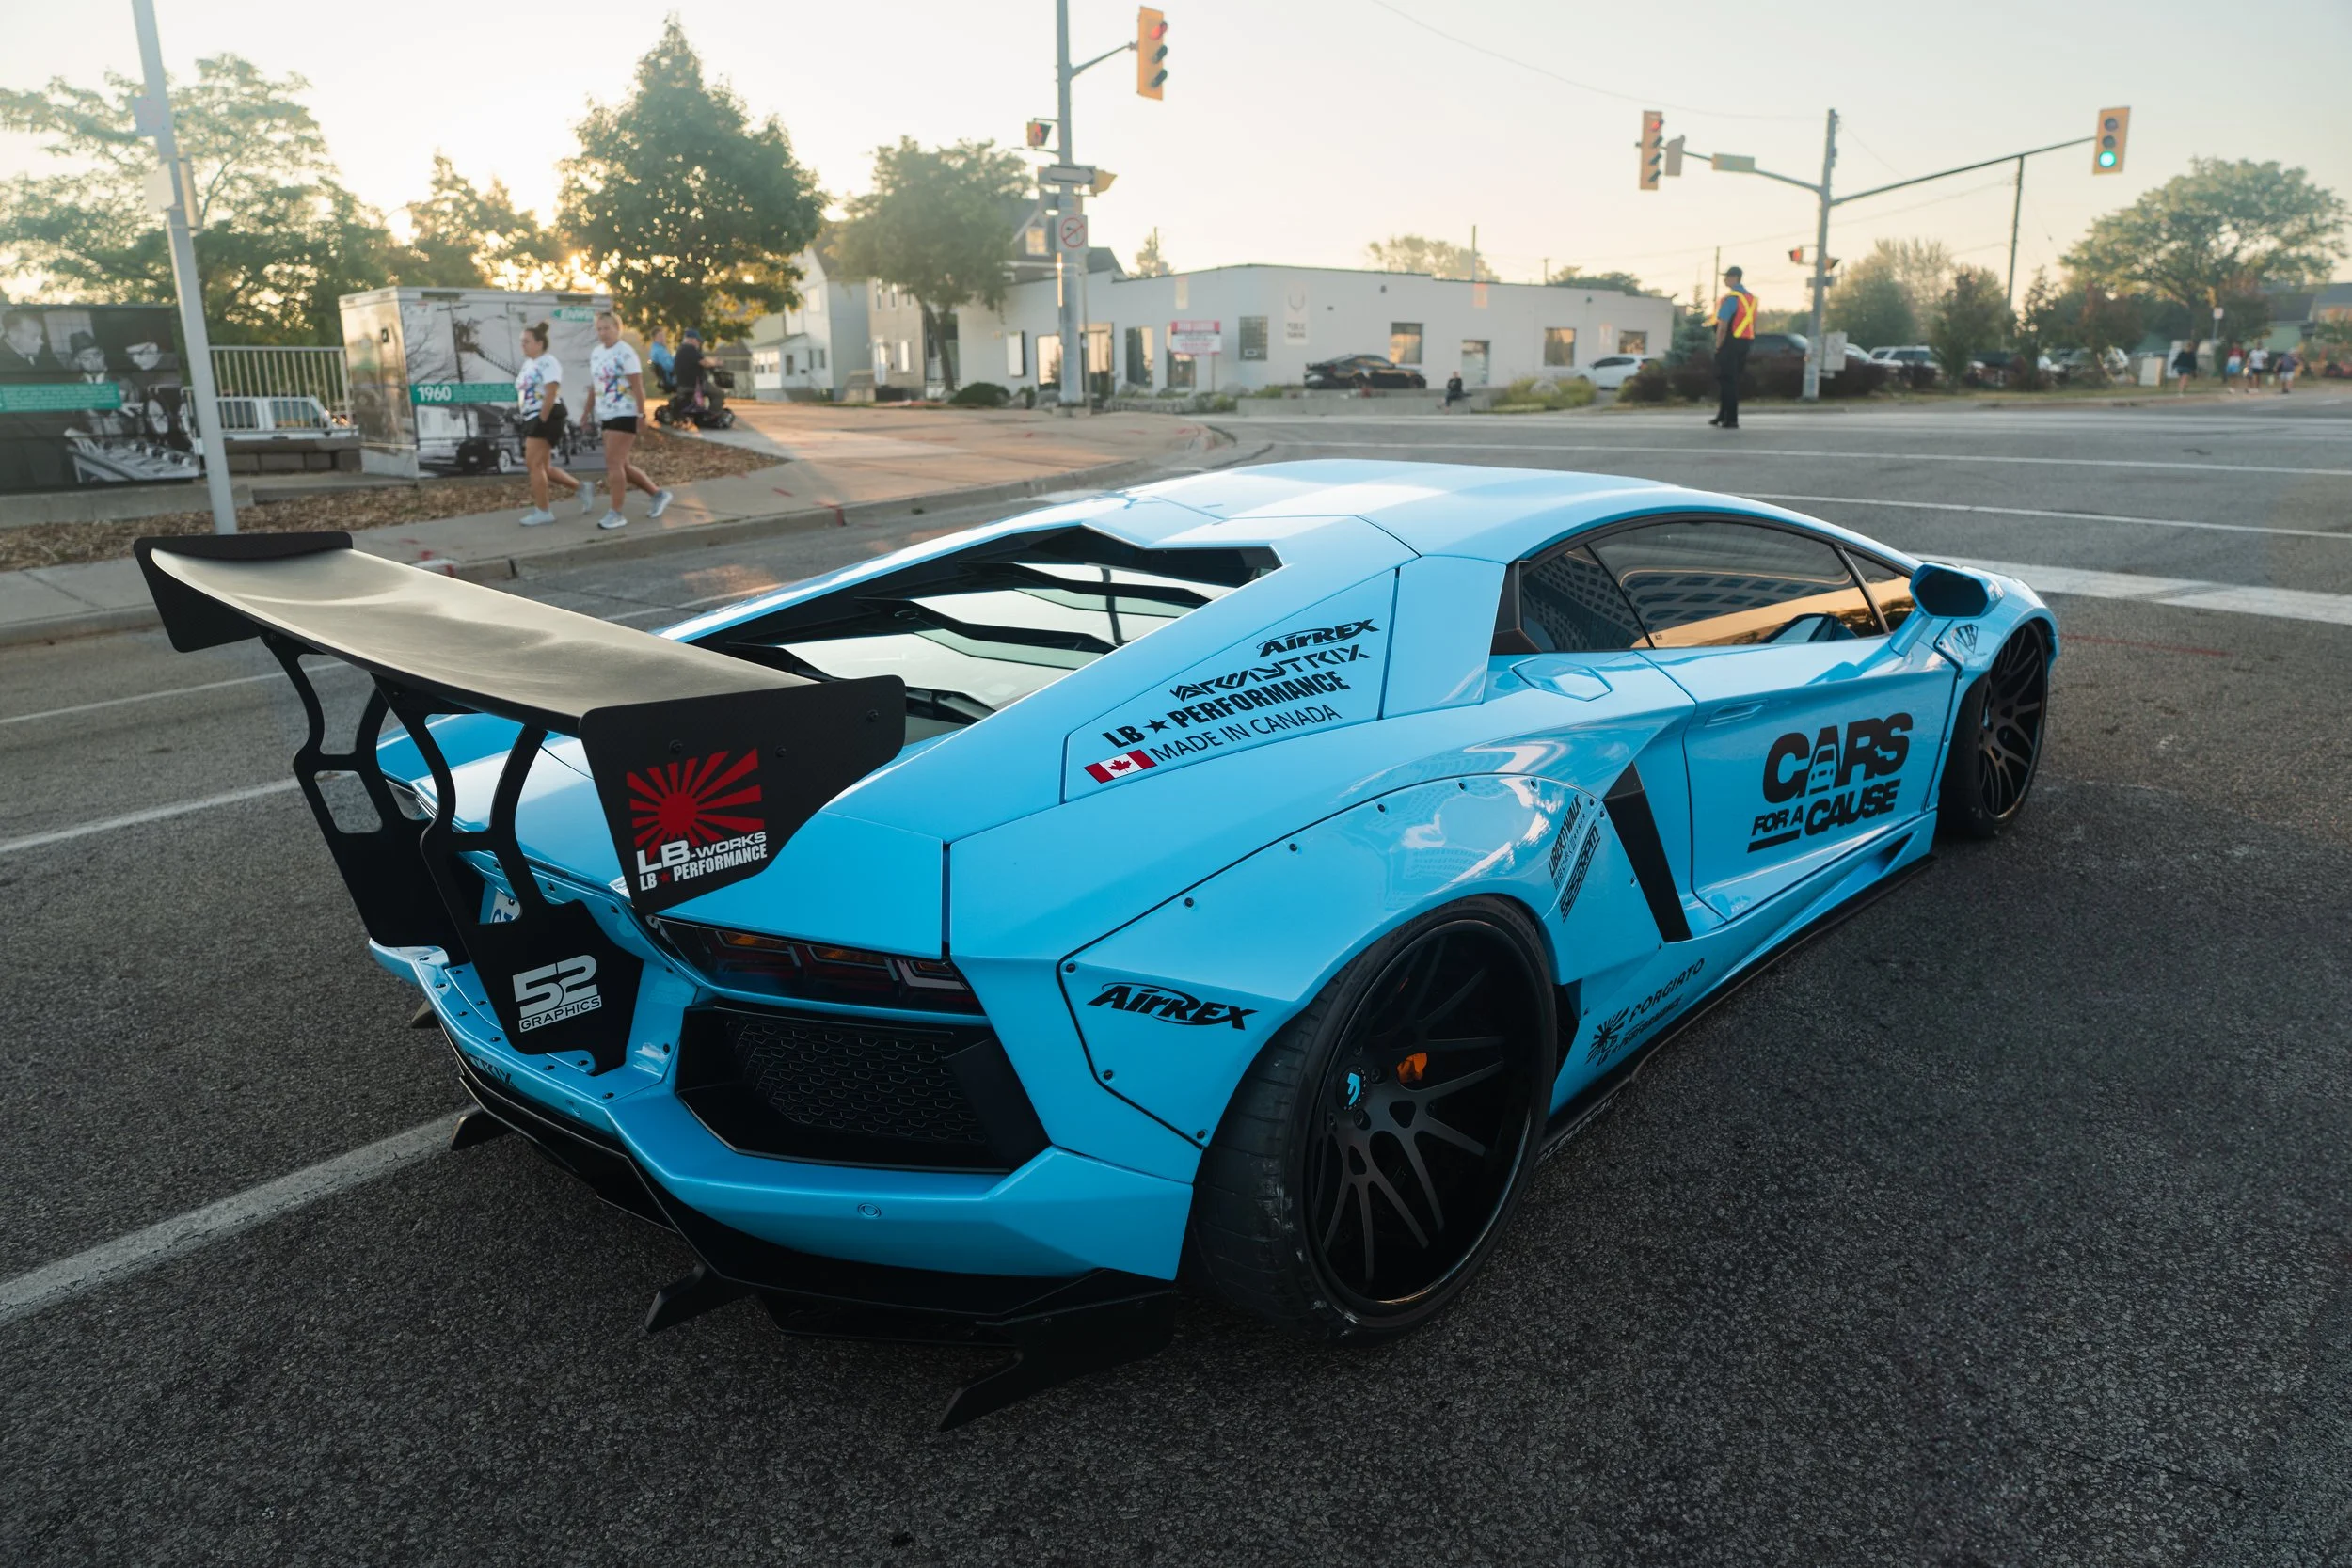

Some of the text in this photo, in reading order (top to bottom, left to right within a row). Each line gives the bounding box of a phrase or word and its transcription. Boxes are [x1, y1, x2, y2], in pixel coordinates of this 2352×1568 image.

[417, 384, 452, 402] 1960
[1102, 670, 1351, 749] LB PERFORMANCE
[1149, 704, 1343, 762] MADE IN CANADA
[1762, 712, 1914, 804] CARS
[1751, 779, 1901, 836] FOR A CAUSE
[639, 844, 768, 891] LB PERFORMANCE
[512, 954, 598, 1019] 52
[520, 996, 601, 1031] GRAPHICS
[1629, 957, 1705, 1023] FORGIATO
